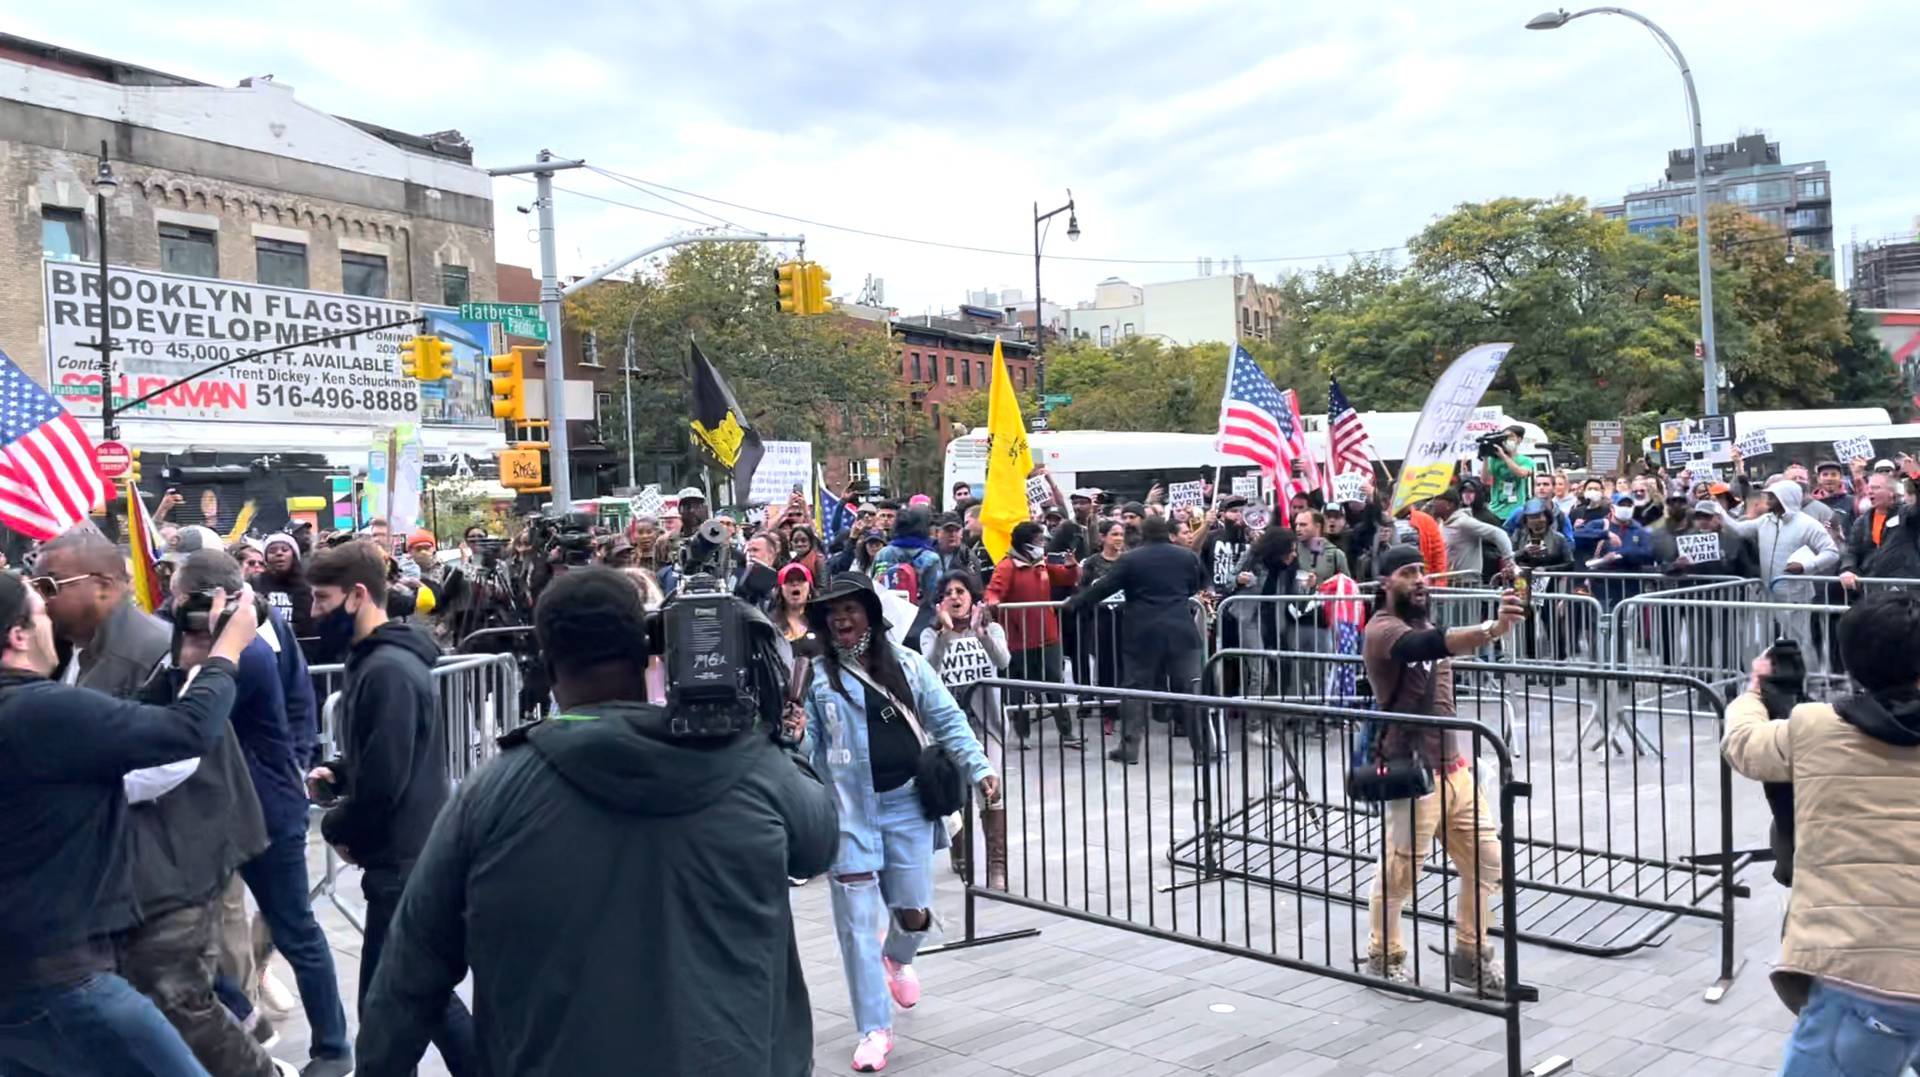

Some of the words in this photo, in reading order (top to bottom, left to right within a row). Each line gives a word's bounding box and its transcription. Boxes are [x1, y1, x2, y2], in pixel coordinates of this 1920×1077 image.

[52, 269, 251, 314] BROOKLYN
[265, 294, 411, 329] FLAGSHIP
[461, 303, 523, 320] Flatbush
[53, 300, 361, 350] REDEVELOPMENT
[127, 338, 154, 355] TO
[166, 342, 230, 361] 45,000
[236, 348, 268, 364] SQ.
[272, 351, 297, 366] FT.
[302, 352, 394, 372] AVAILABLE
[57, 356, 118, 372] Contat
[228, 365, 263, 380] Trent
[268, 368, 310, 384] Dickey
[322, 372, 345, 384] Ken
[348, 373, 416, 389] Schuckman
[256, 384, 418, 412] 516-496-8888
[1736, 438, 1767, 450] WITH
[1170, 482, 1200, 493] STAND
[1172, 490, 1200, 500] WITH
[1678, 534, 1716, 544] STAND
[1682, 543, 1715, 554] WITH
[1690, 552, 1718, 561] YRIE
[944, 641, 985, 654] TAND
[942, 652, 988, 670] WITH
[940, 666, 992, 685] KYRIE
